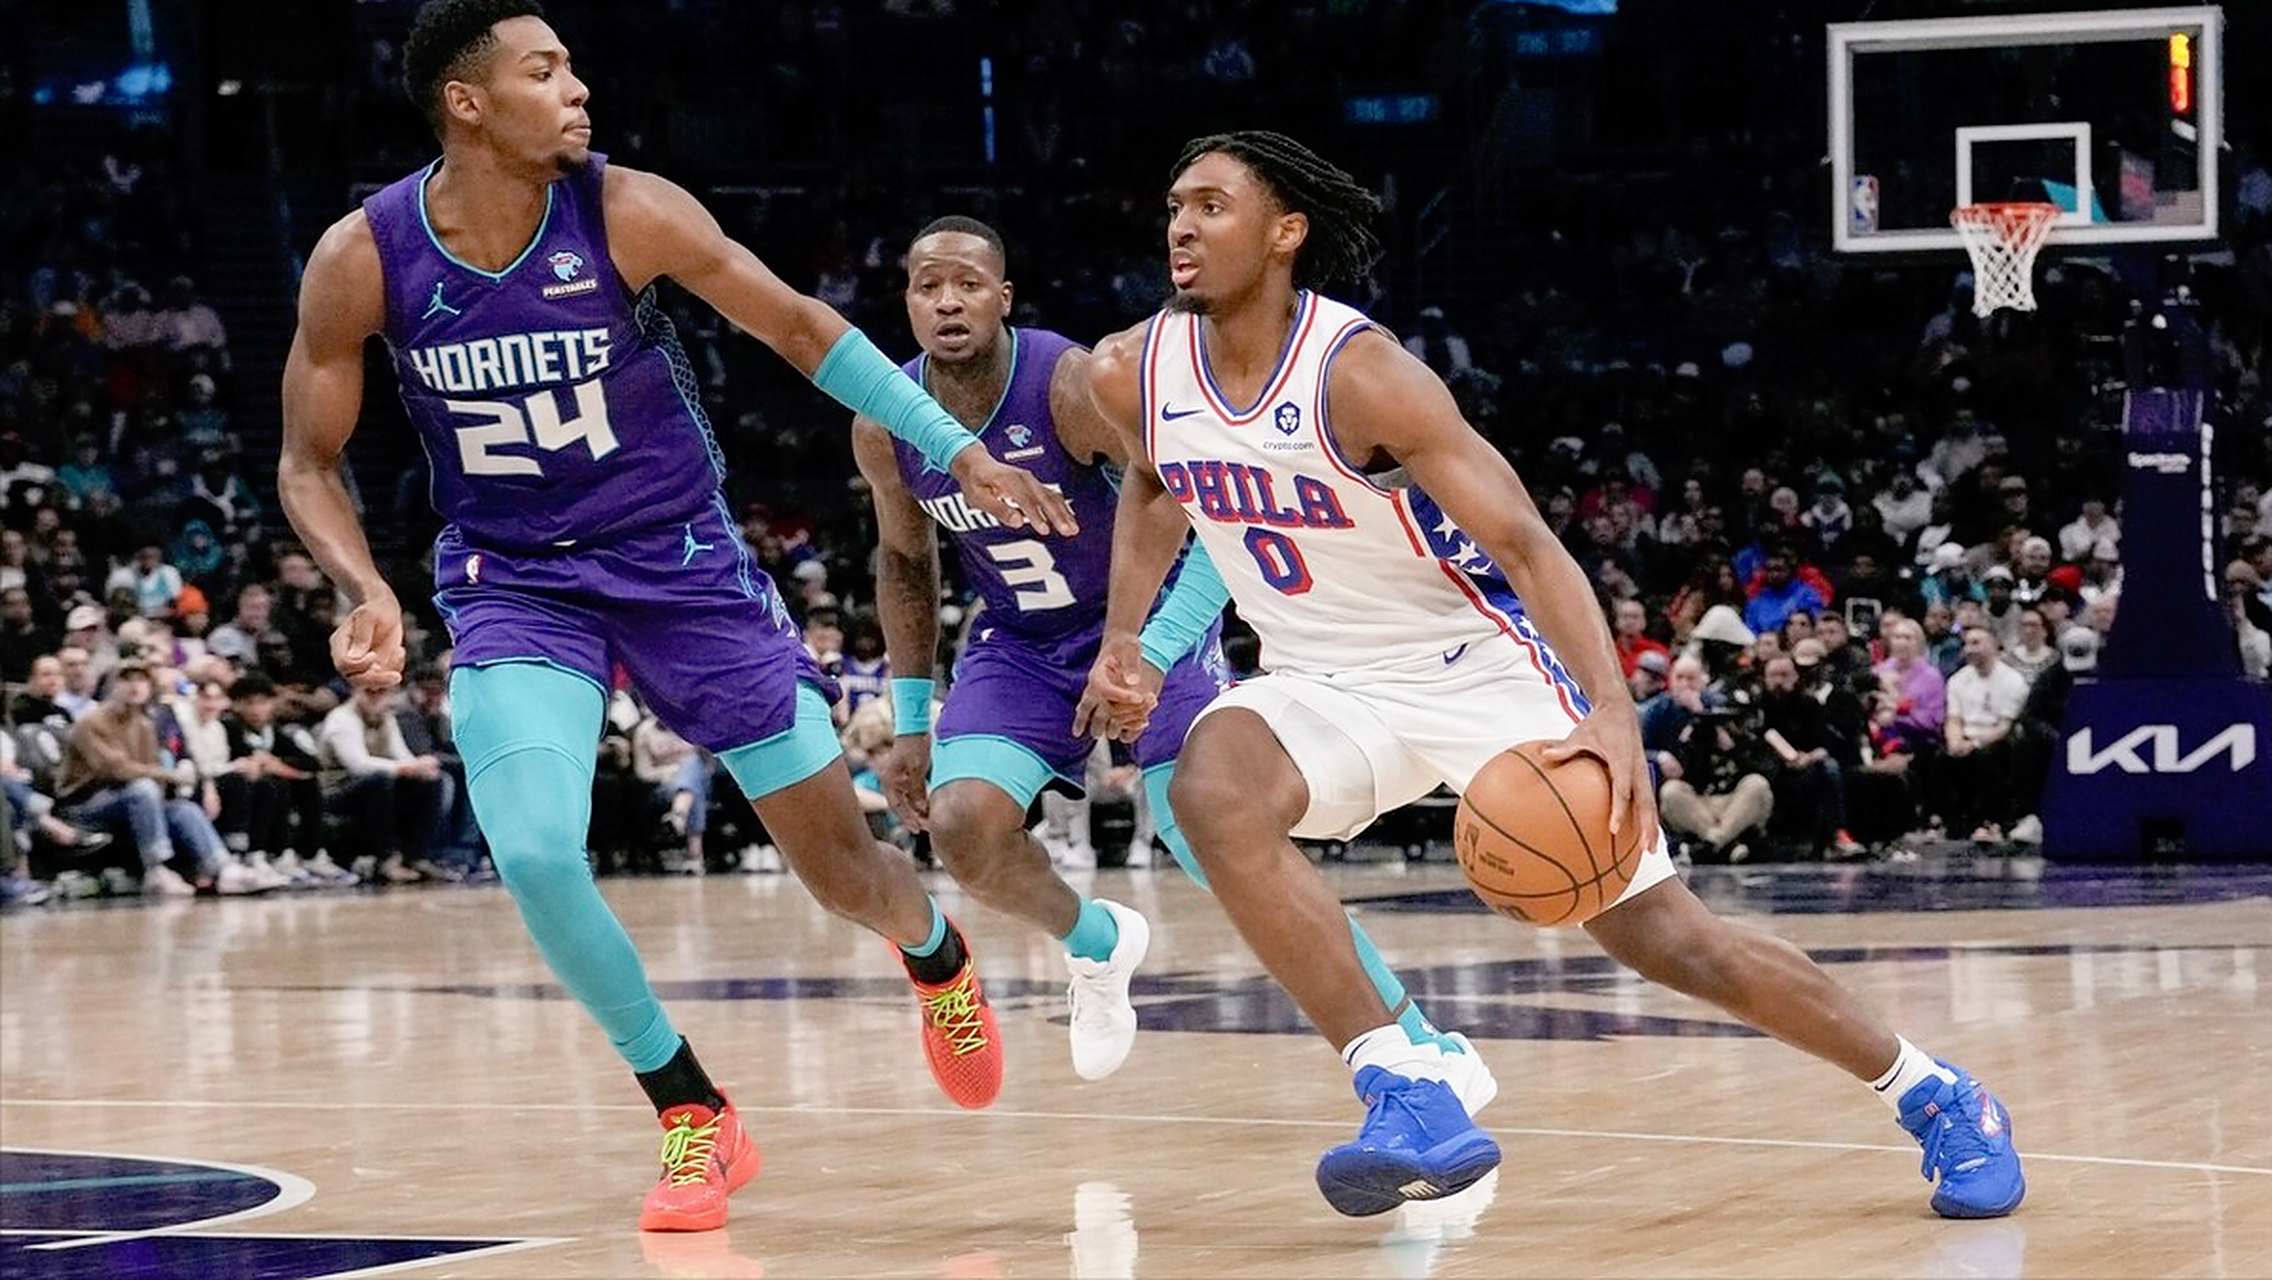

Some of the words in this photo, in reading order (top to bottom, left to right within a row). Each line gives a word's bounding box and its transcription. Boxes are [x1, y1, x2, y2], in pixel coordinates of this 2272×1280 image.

[411, 328, 614, 392] HORNETS
[446, 378, 620, 478] 24
[1159, 460, 1355, 528] PHILA
[986, 539, 1077, 611] 3
[1243, 526, 1314, 596] 0
[2067, 723, 2256, 774] KIA
